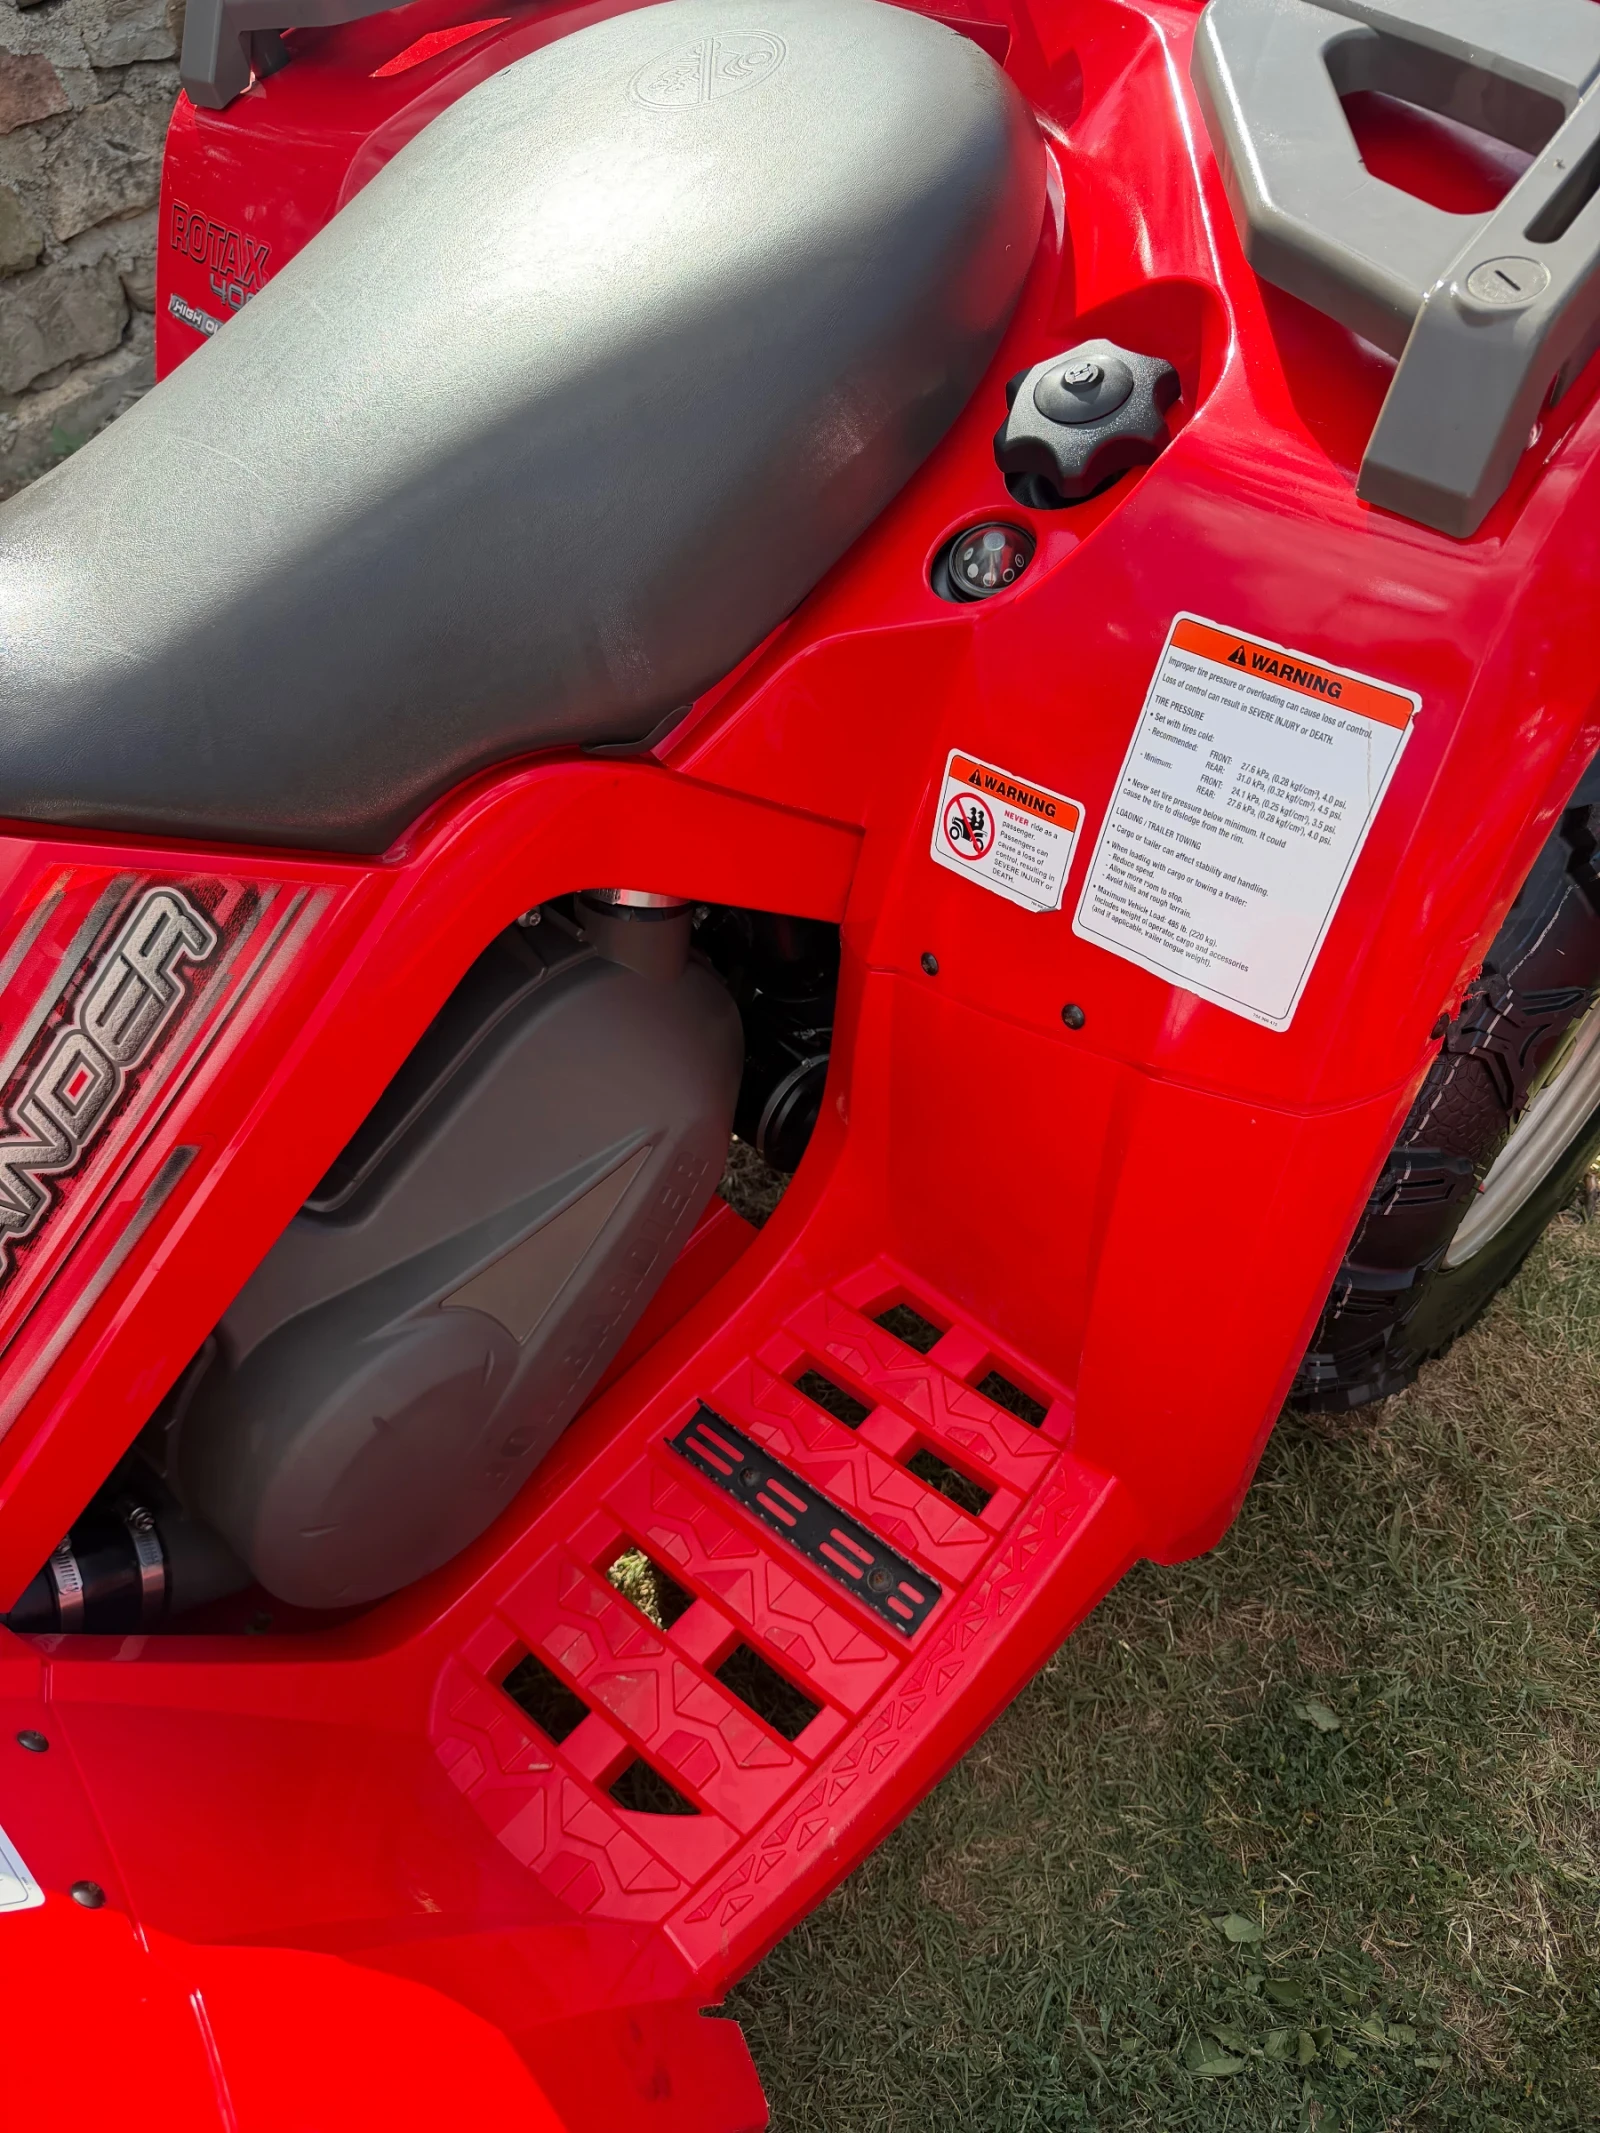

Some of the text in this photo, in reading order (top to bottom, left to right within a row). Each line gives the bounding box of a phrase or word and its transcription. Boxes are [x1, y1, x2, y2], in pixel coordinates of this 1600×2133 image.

[171, 203, 269, 292] ROTAX
[173, 300, 202, 325] HIGH
[210, 273, 258, 313] 40
[1168, 656, 1373, 739] Improper tire pressure or overloading can cause loss of control.
[1252, 652, 1342, 699] WARNING
[1154, 712, 1215, 742] Set with tires cold:
[1155, 695, 1205, 721] TIRE PRESSURE
[1162, 673, 1333, 745] Loss of control can result in SEVERE INJURY or DEATH.
[1152, 727, 1198, 752] Recommended:
[1209, 750, 1233, 765] FRONT:
[1241, 762, 1256, 774] 27.6
[1256, 767, 1270, 781] kPa,
[1272, 774, 1290, 787] (0.28
[1322, 793, 1334, 804] 4.0
[1333, 799, 1347, 810] psi.
[1205, 761, 1225, 775] REAR:
[1236, 773, 1252, 785] 31.0
[1252, 779, 1266, 792] kPa,
[1267, 785, 1286, 798] (0.32
[1317, 805, 1330, 816] 4.5
[1329, 811, 1342, 821] psi.
[985, 775, 1057, 818] WARNING
[1123, 788, 1142, 801] cause
[1153, 800, 1164, 811] tire
[1165, 805, 1172, 814] to
[1172, 809, 1201, 826] dislodge
[1201, 820, 1218, 833] from
[1230, 833, 1244, 844] rim.
[1132, 778, 1287, 849] Never set tire pressure below minimum. It could
[1144, 752, 1172, 769] Minimum:
[1200, 774, 1223, 789] FRONT:
[1231, 787, 1246, 798] 24.1
[1246, 792, 1260, 806] kPa,
[1262, 799, 1280, 812] (0.25
[1312, 818, 1324, 829] 3.5
[1323, 825, 1336, 835] psi.
[1196, 785, 1216, 799] REAR:
[1227, 798, 1242, 810] 27.6
[1242, 804, 1256, 817] kPa,
[1257, 810, 1276, 823] (0.28
[1307, 830, 1319, 841] 4.0
[1318, 836, 1332, 846] psi.
[1000, 830, 1049, 858] Passengers can
[1002, 821, 1036, 841] passenger.
[1004, 810, 1029, 826] NEVER
[1031, 823, 1044, 833] ride
[1116, 807, 1144, 825] LOADING
[1148, 821, 1175, 838] TRAILER
[1176, 833, 1202, 850] TOWING
[992, 867, 1013, 883] DEATH.
[994, 858, 1020, 876] SEVERE
[1021, 871, 1045, 887] INJURY
[996, 850, 1055, 882] control, resulting in
[998, 841, 1016, 853] cause
[1022, 851, 1036, 863] loss
[1112, 853, 1135, 869] Reduce
[1112, 841, 1129, 854] When
[1152, 861, 1166, 872] with
[1167, 868, 1186, 881] cargo
[1195, 879, 1218, 896] towing
[1225, 892, 1248, 907] trailer:
[1117, 824, 1135, 838] Cargo
[1144, 837, 1162, 850] trailer
[1162, 847, 1175, 856] can
[1175, 852, 1195, 865] affect
[1195, 861, 1223, 878] stability
[1223, 873, 1237, 883] and
[1237, 877, 1268, 897] handling.
[1105, 873, 1124, 886] Avoid
[1137, 889, 1150, 899] and
[1150, 895, 1168, 907] rough
[1169, 903, 1191, 919] terrain.
[1109, 863, 1127, 876] Allow
[1127, 873, 1143, 884] more
[1160, 887, 1167, 896] to
[1168, 892, 1183, 903] stop.
[1098, 885, 1127, 904] Maximum
[1149, 910, 1166, 923] Load:
[1167, 919, 1179, 930] 485
[1189, 929, 1205, 941] (220
[1205, 936, 1217, 948] kg).
[1111, 915, 1143, 935] applicable,
[1163, 939, 1184, 955] tongue
[1185, 951, 1211, 968] weight).
[1120, 908, 1141, 922] weight
[1148, 922, 1175, 940] operator,
[1176, 936, 1195, 948] cargo
[1195, 944, 1209, 955] and
[1209, 951, 1249, 972] accessories
